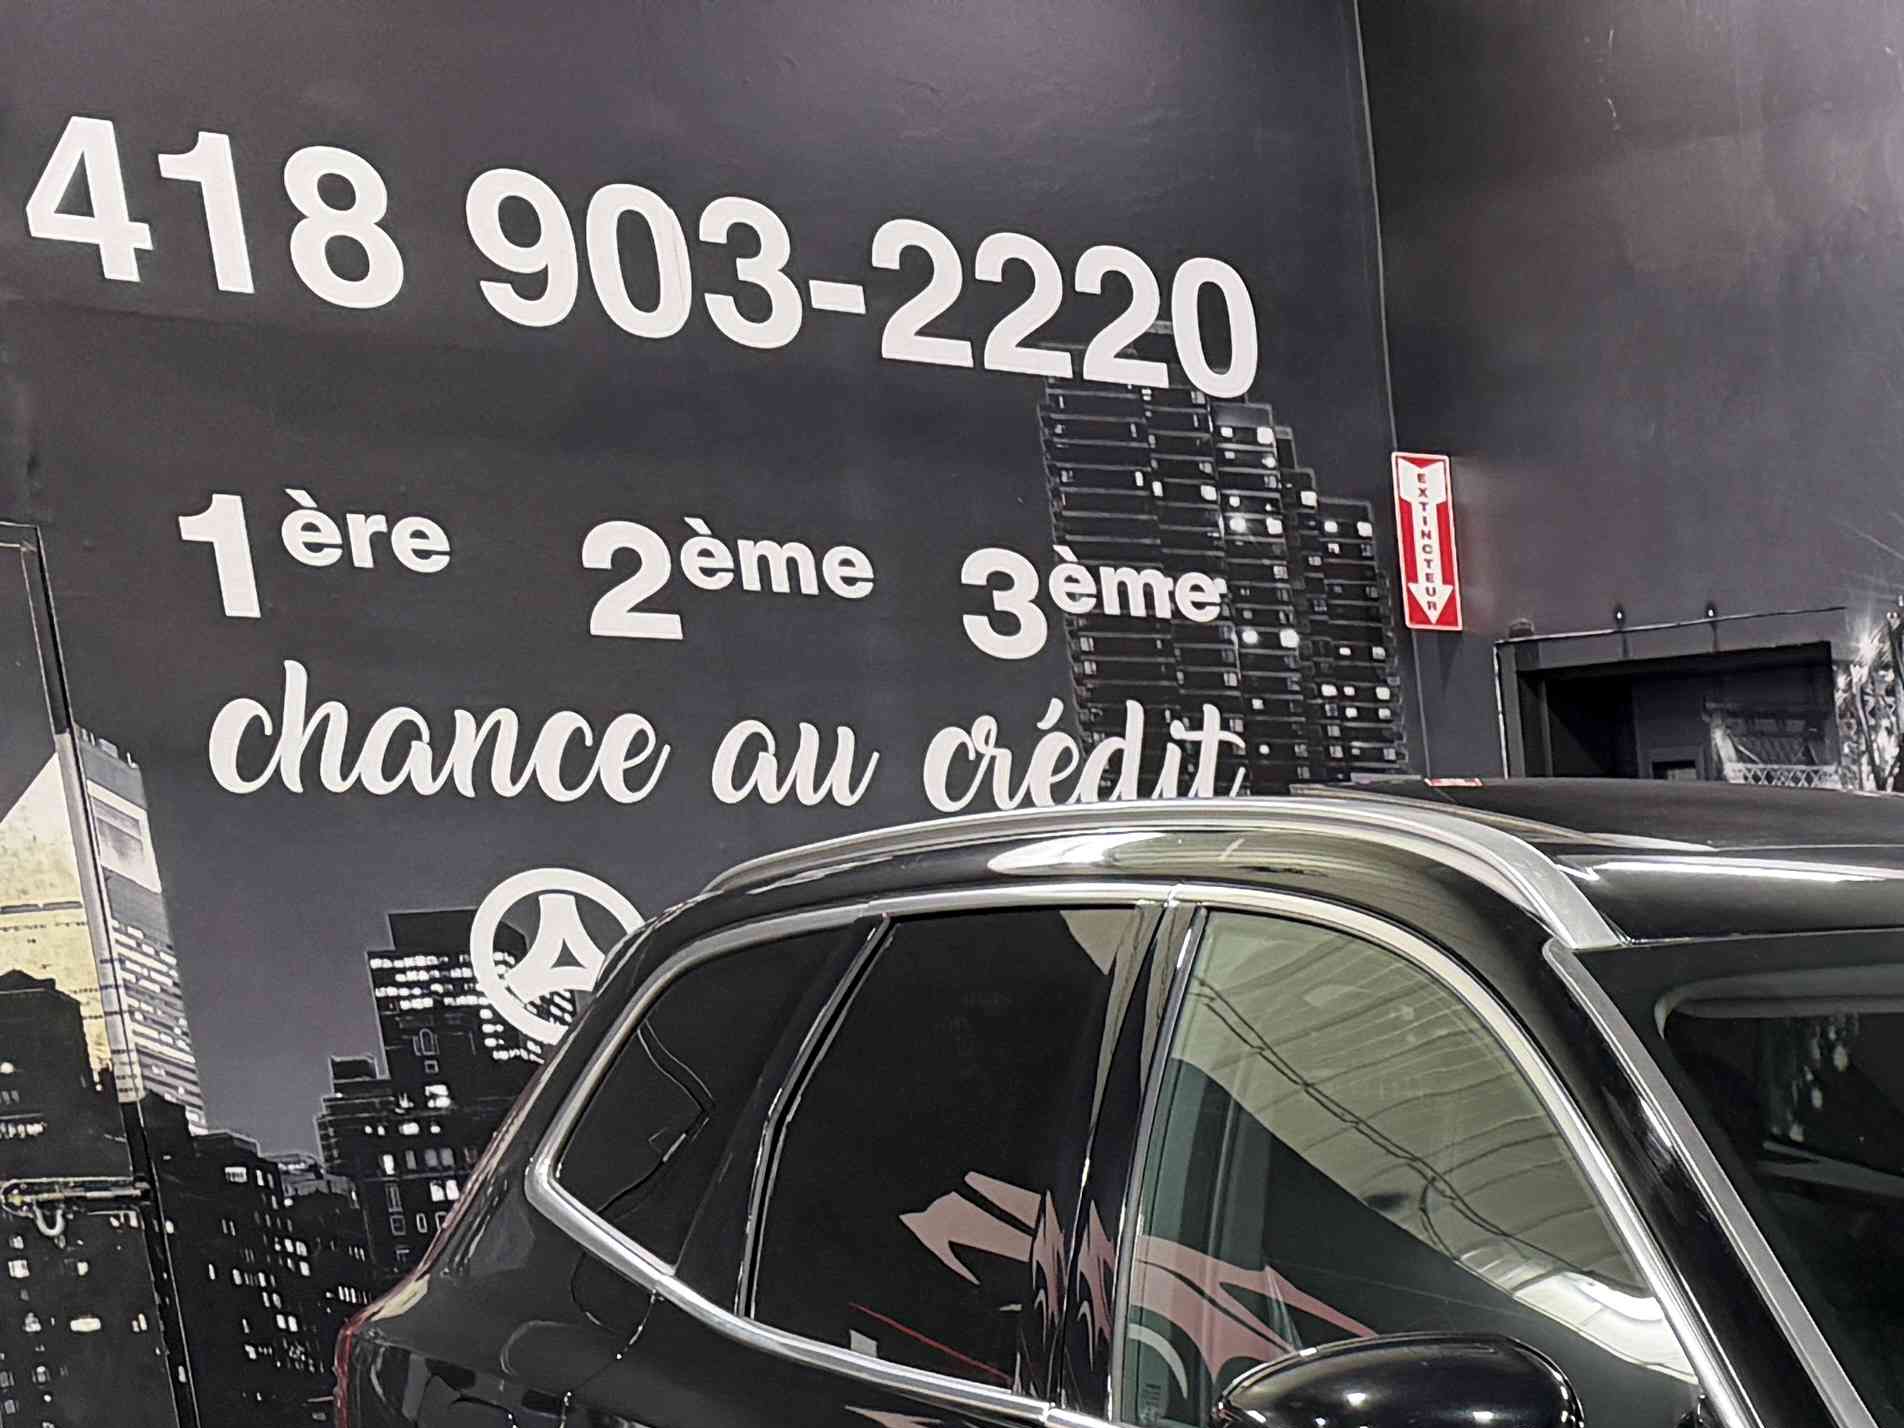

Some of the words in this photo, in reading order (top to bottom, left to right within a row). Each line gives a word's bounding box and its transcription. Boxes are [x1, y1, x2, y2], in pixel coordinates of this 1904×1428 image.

[26, 116, 403, 308] 418
[466, 169, 1257, 398] 903-2220
[179, 489, 450, 617] 1ère
[582, 517, 874, 639] 2ème
[961, 545, 1227, 659] 3ème
[1416, 472, 1438, 611] EXTINCTEUR
[209, 660, 670, 804] chance
[712, 720, 879, 807] au
[923, 698, 1247, 813] crédit
